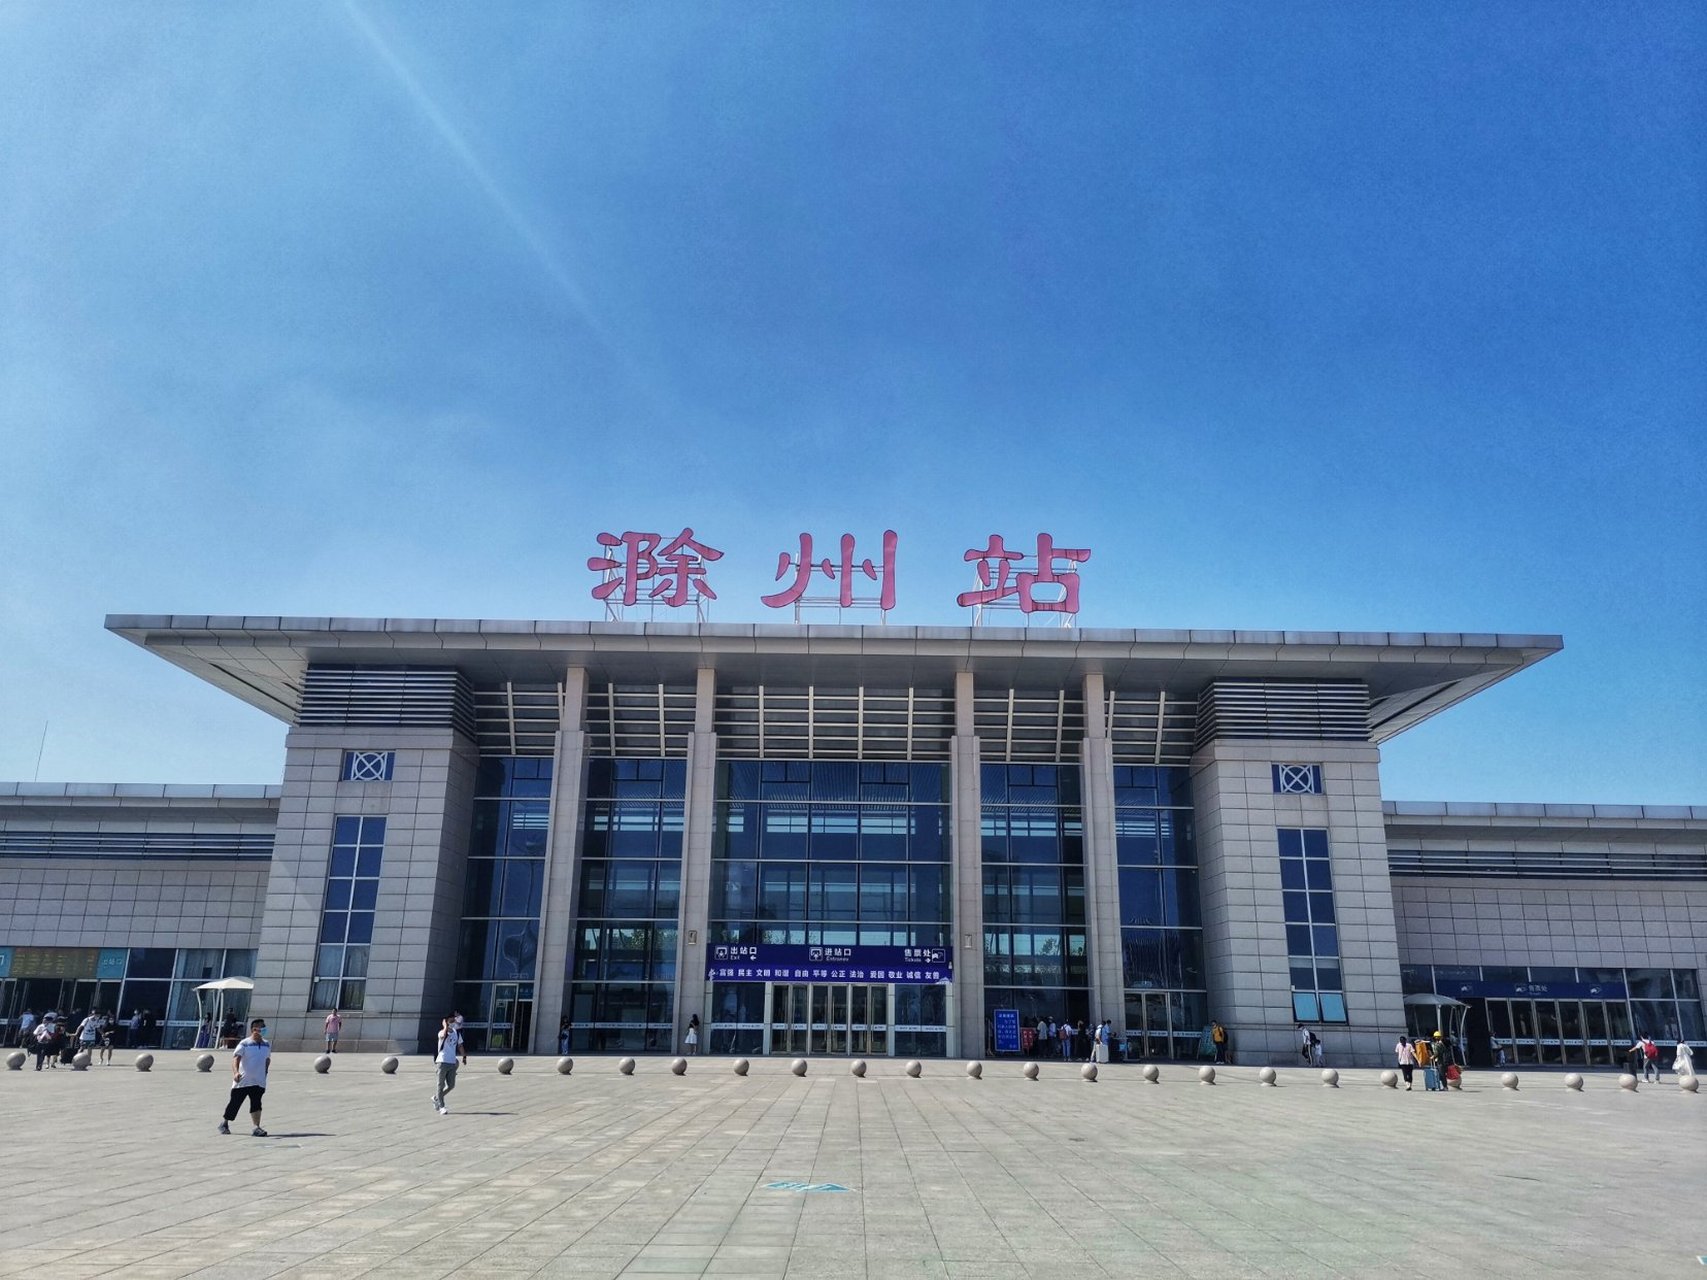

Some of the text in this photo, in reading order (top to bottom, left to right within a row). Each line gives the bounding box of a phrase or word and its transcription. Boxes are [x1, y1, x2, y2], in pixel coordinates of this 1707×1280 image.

[587, 528, 1091, 613] 滁州站
[730, 946, 757, 955] 出站口
[824, 947, 851, 956] 进站口
[904, 948, 931, 957] 售票处
[719, 968, 940, 979] 富强 民主 文明 和谐 自由 平等 公正 法治 爱国 敬业 诚信 友善
